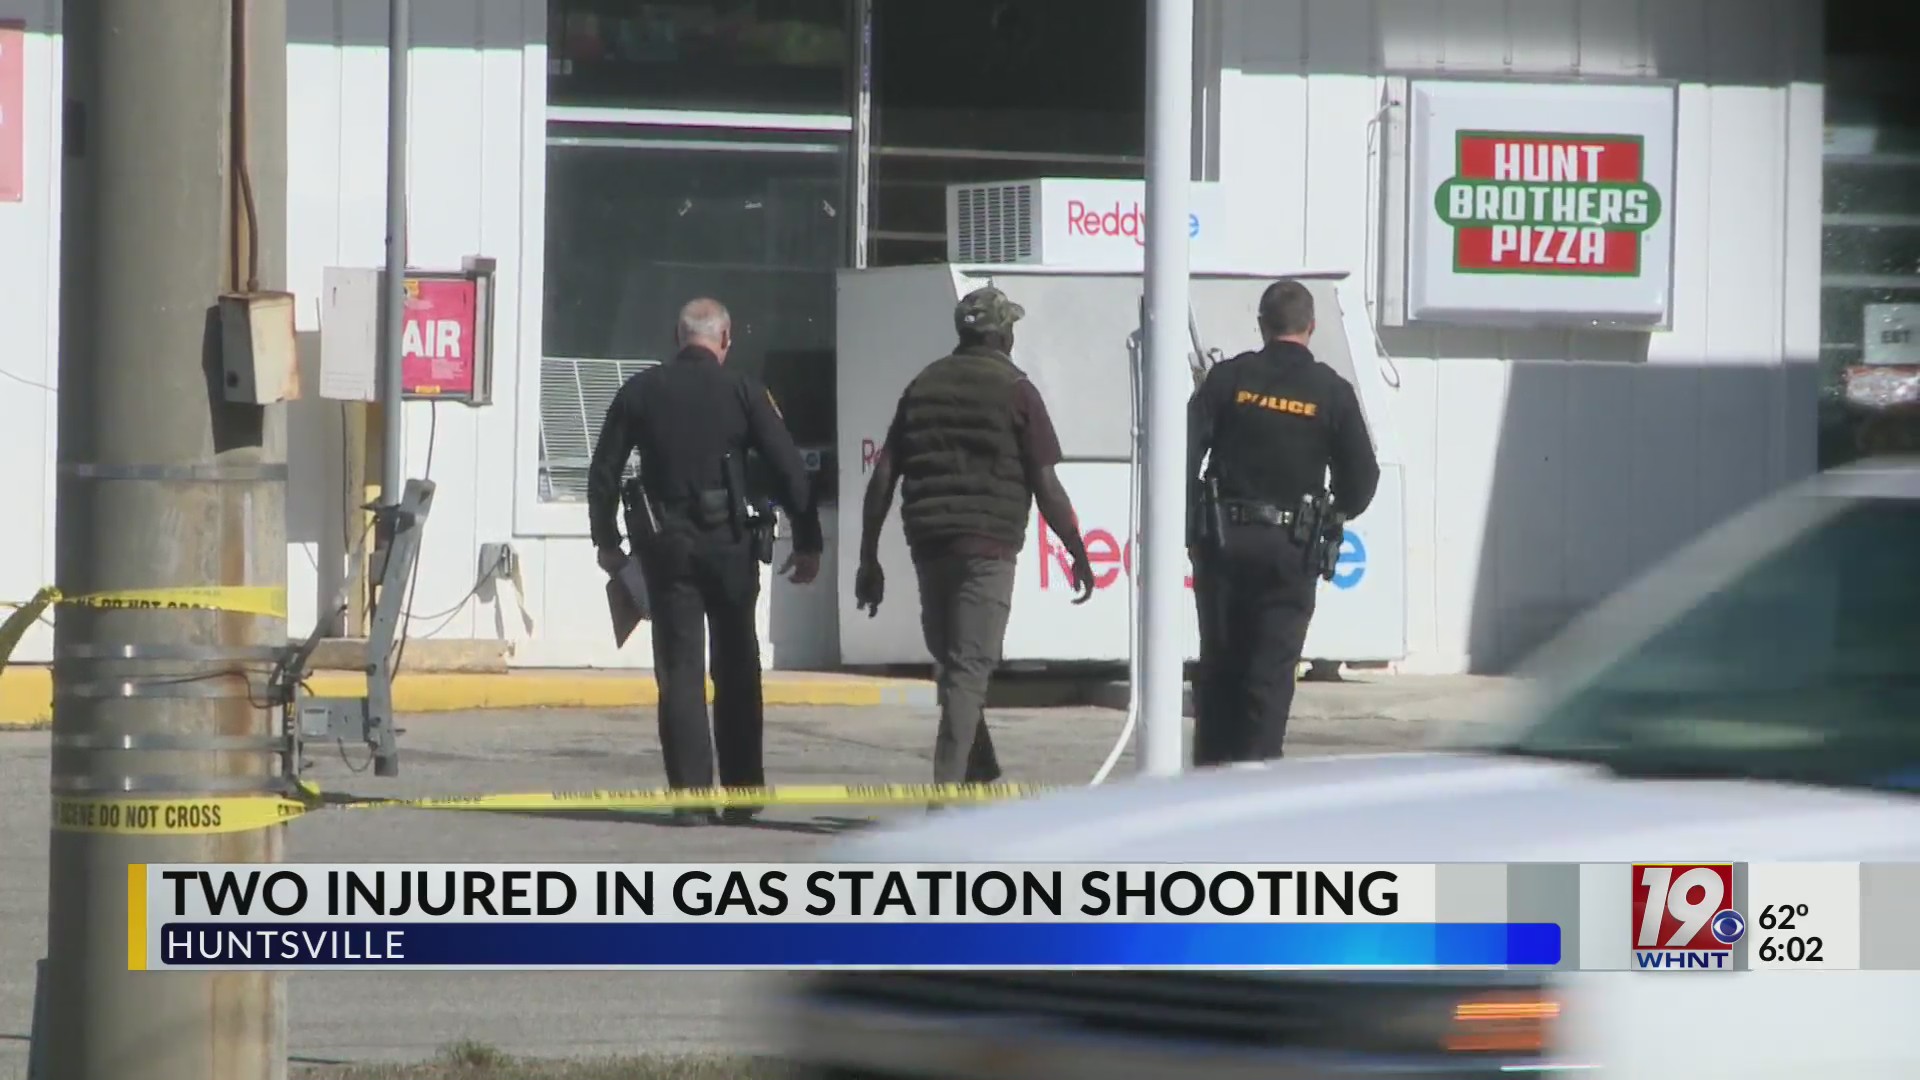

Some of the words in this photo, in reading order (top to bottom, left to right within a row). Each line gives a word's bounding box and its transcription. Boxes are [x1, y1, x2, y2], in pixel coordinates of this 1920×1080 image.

[1494, 142, 1605, 183] HUNT
[1449, 184, 1648, 224] BROTHERS
[1491, 224, 1605, 264] PIZZA
[401, 319, 461, 358] AIR
[1236, 389, 1318, 417] POLICE
[100, 804, 120, 828] DO
[125, 805, 159, 829] NOT
[165, 804, 222, 829] CROSS
